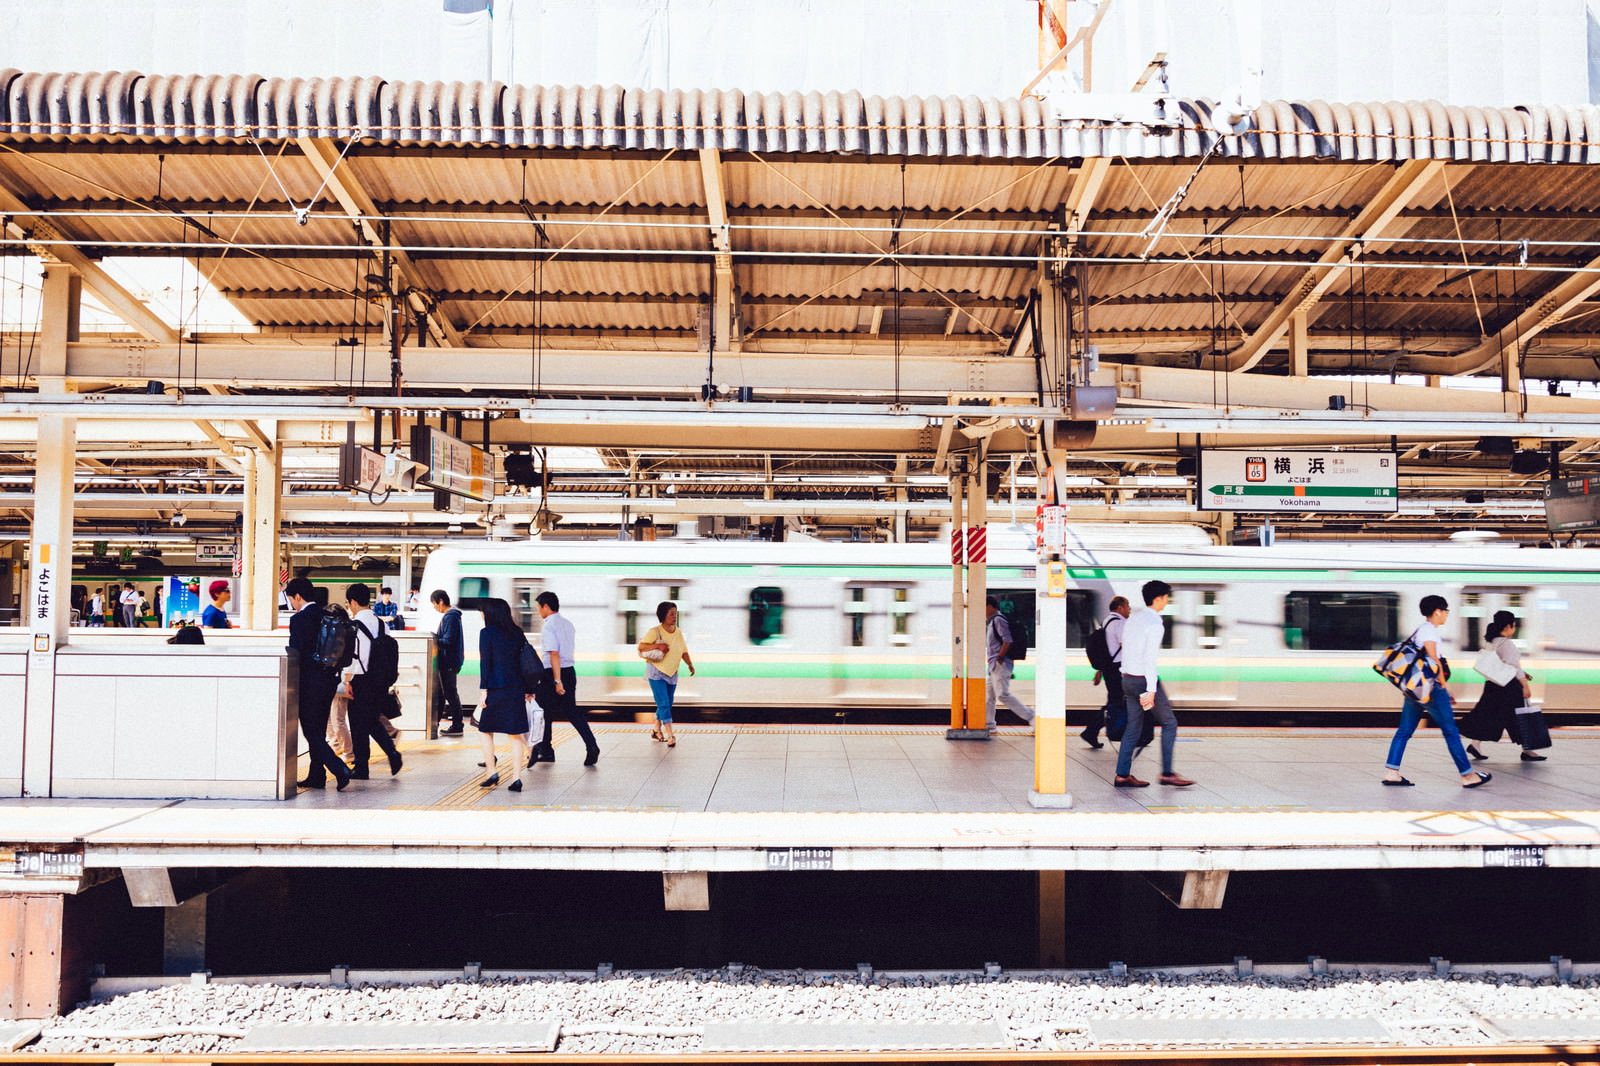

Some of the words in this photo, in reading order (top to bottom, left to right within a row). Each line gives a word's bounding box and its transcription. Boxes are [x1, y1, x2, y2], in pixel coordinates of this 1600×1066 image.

[1274, 457, 1325, 474] 横浜
[1545, 484, 1551, 496] 6
[1279, 498, 1321, 506] Yokohama
[38, 568, 50, 619] よこはま
[769, 851, 788, 866] 07
[794, 849, 831, 858] H=1100
